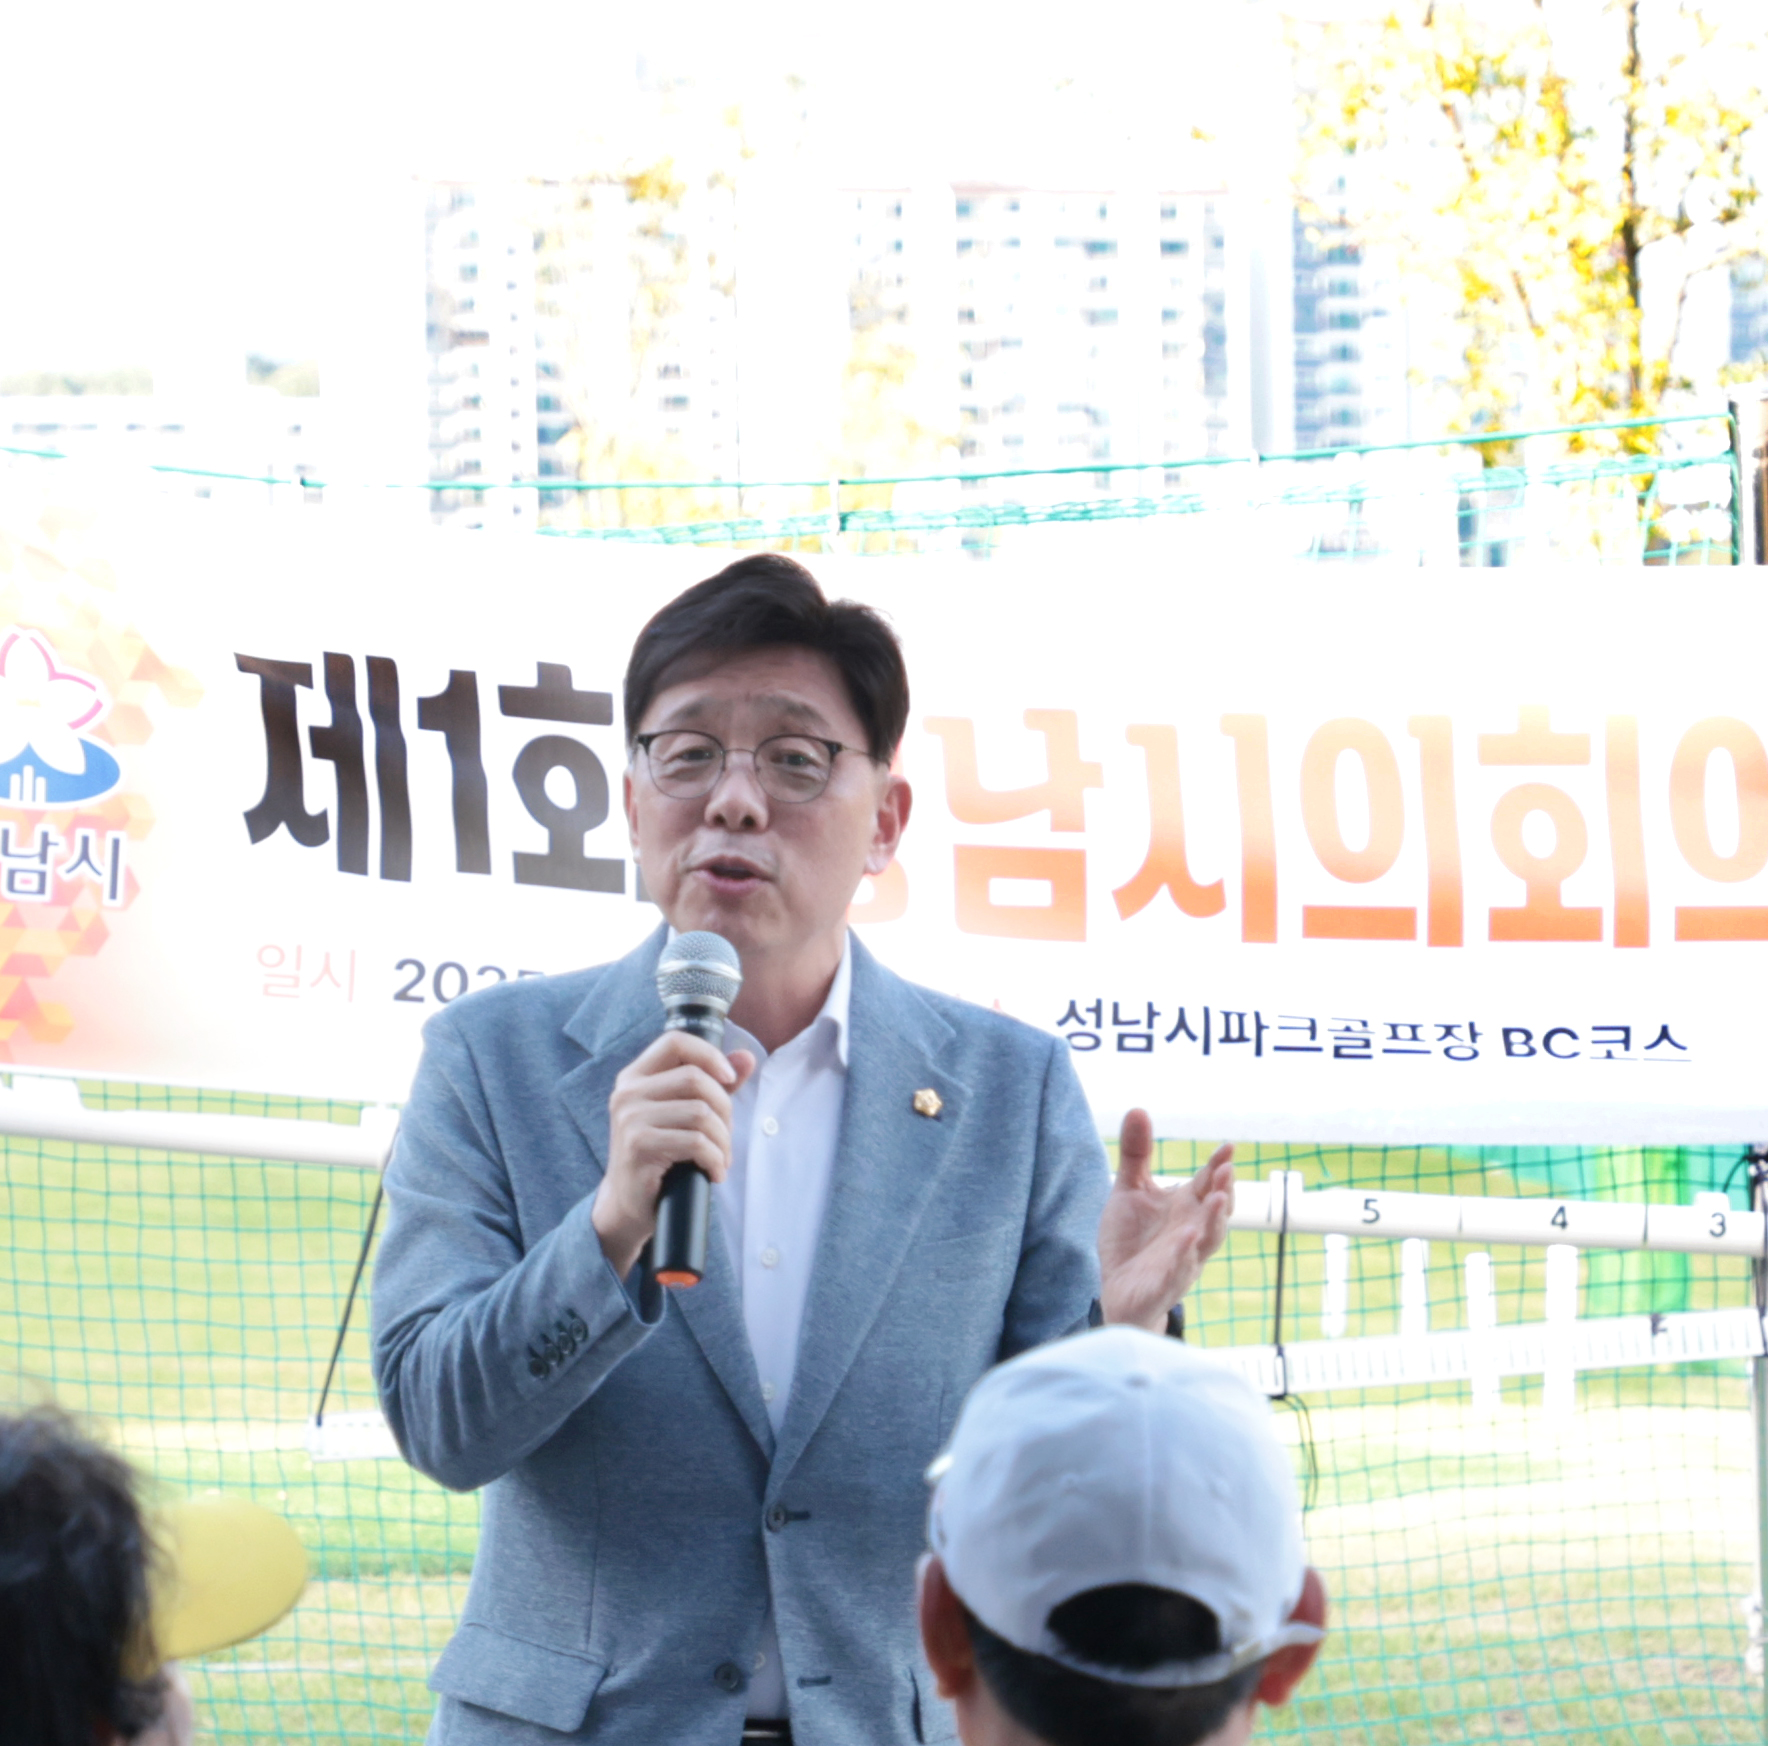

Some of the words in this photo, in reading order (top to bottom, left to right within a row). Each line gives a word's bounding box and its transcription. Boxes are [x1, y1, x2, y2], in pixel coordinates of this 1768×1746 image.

[234, 650, 653, 904] 제1회
[254, 942, 359, 1003] 일시
[1055, 998, 1483, 1063] 성남시파크골프장
[1500, 1021, 1692, 1064] BC코스
[1362, 1198, 1381, 1224] 5
[1550, 1205, 1569, 1230] 4
[1709, 1212, 1727, 1238] 3
